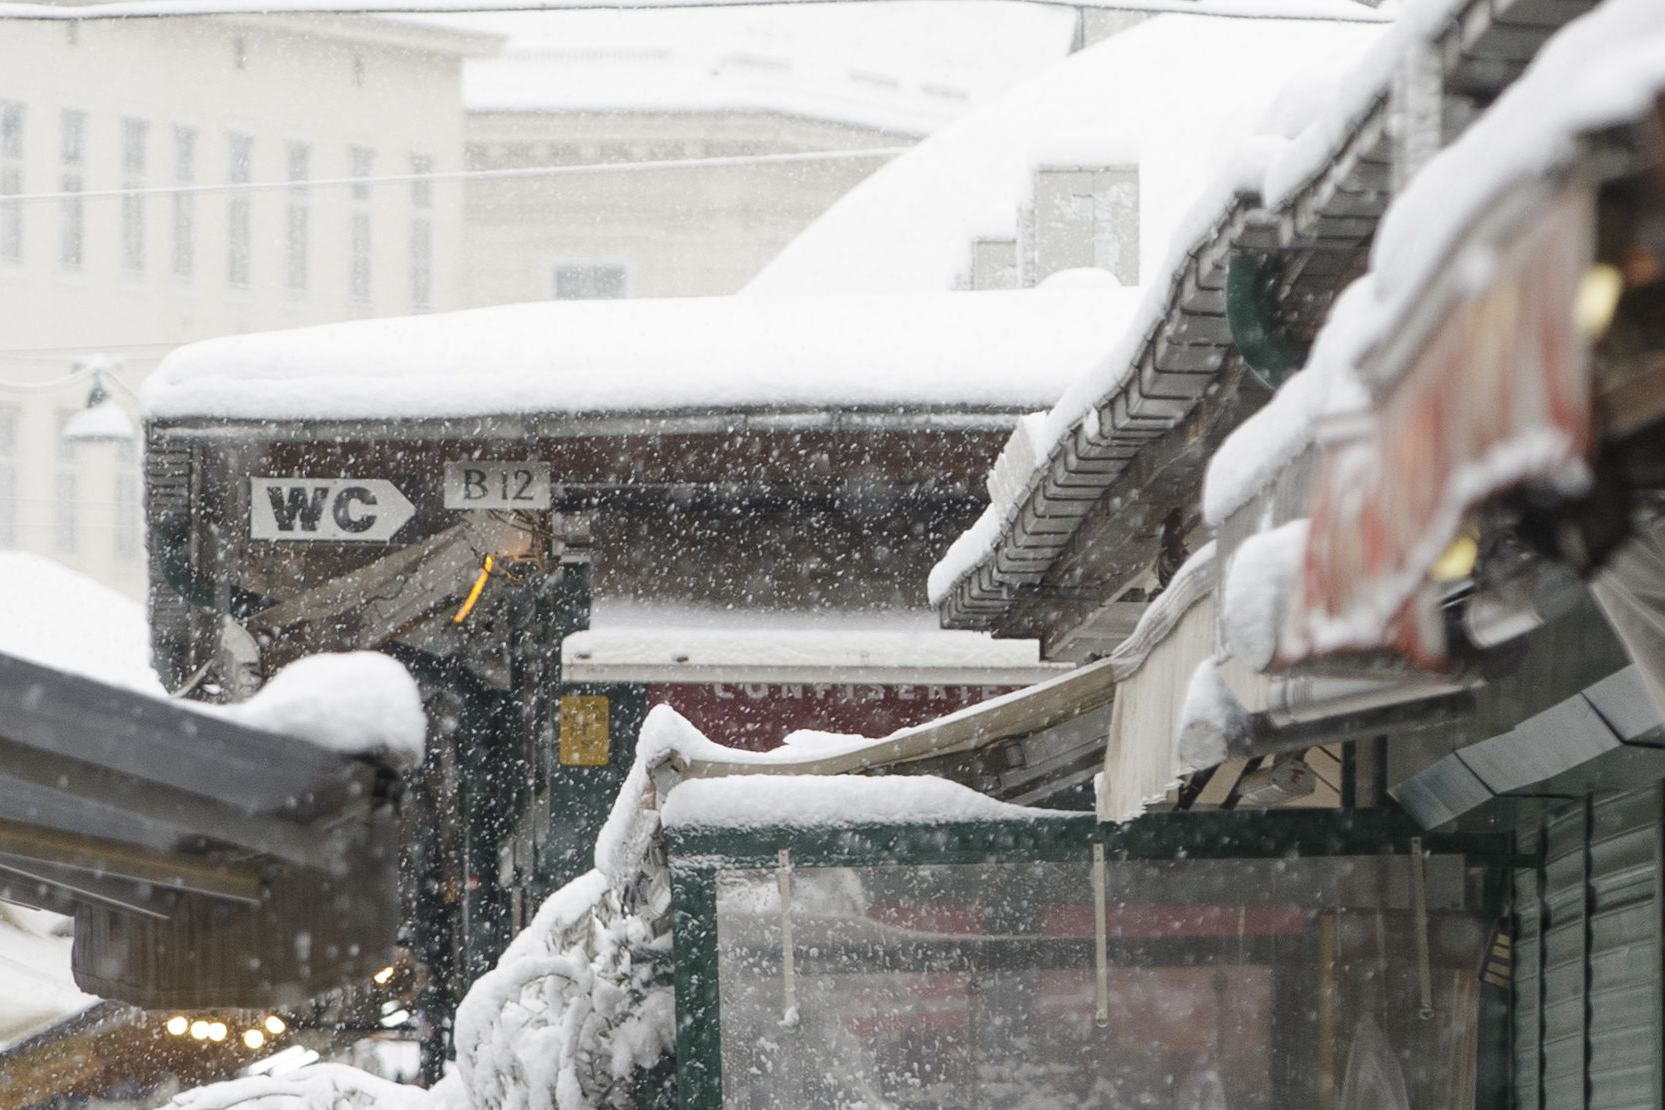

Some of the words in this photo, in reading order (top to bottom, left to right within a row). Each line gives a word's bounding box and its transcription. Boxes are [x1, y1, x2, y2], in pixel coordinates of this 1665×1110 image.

[464, 469, 488, 500] B
[500, 469, 534, 500] 12
[266, 486, 378, 533] WC
